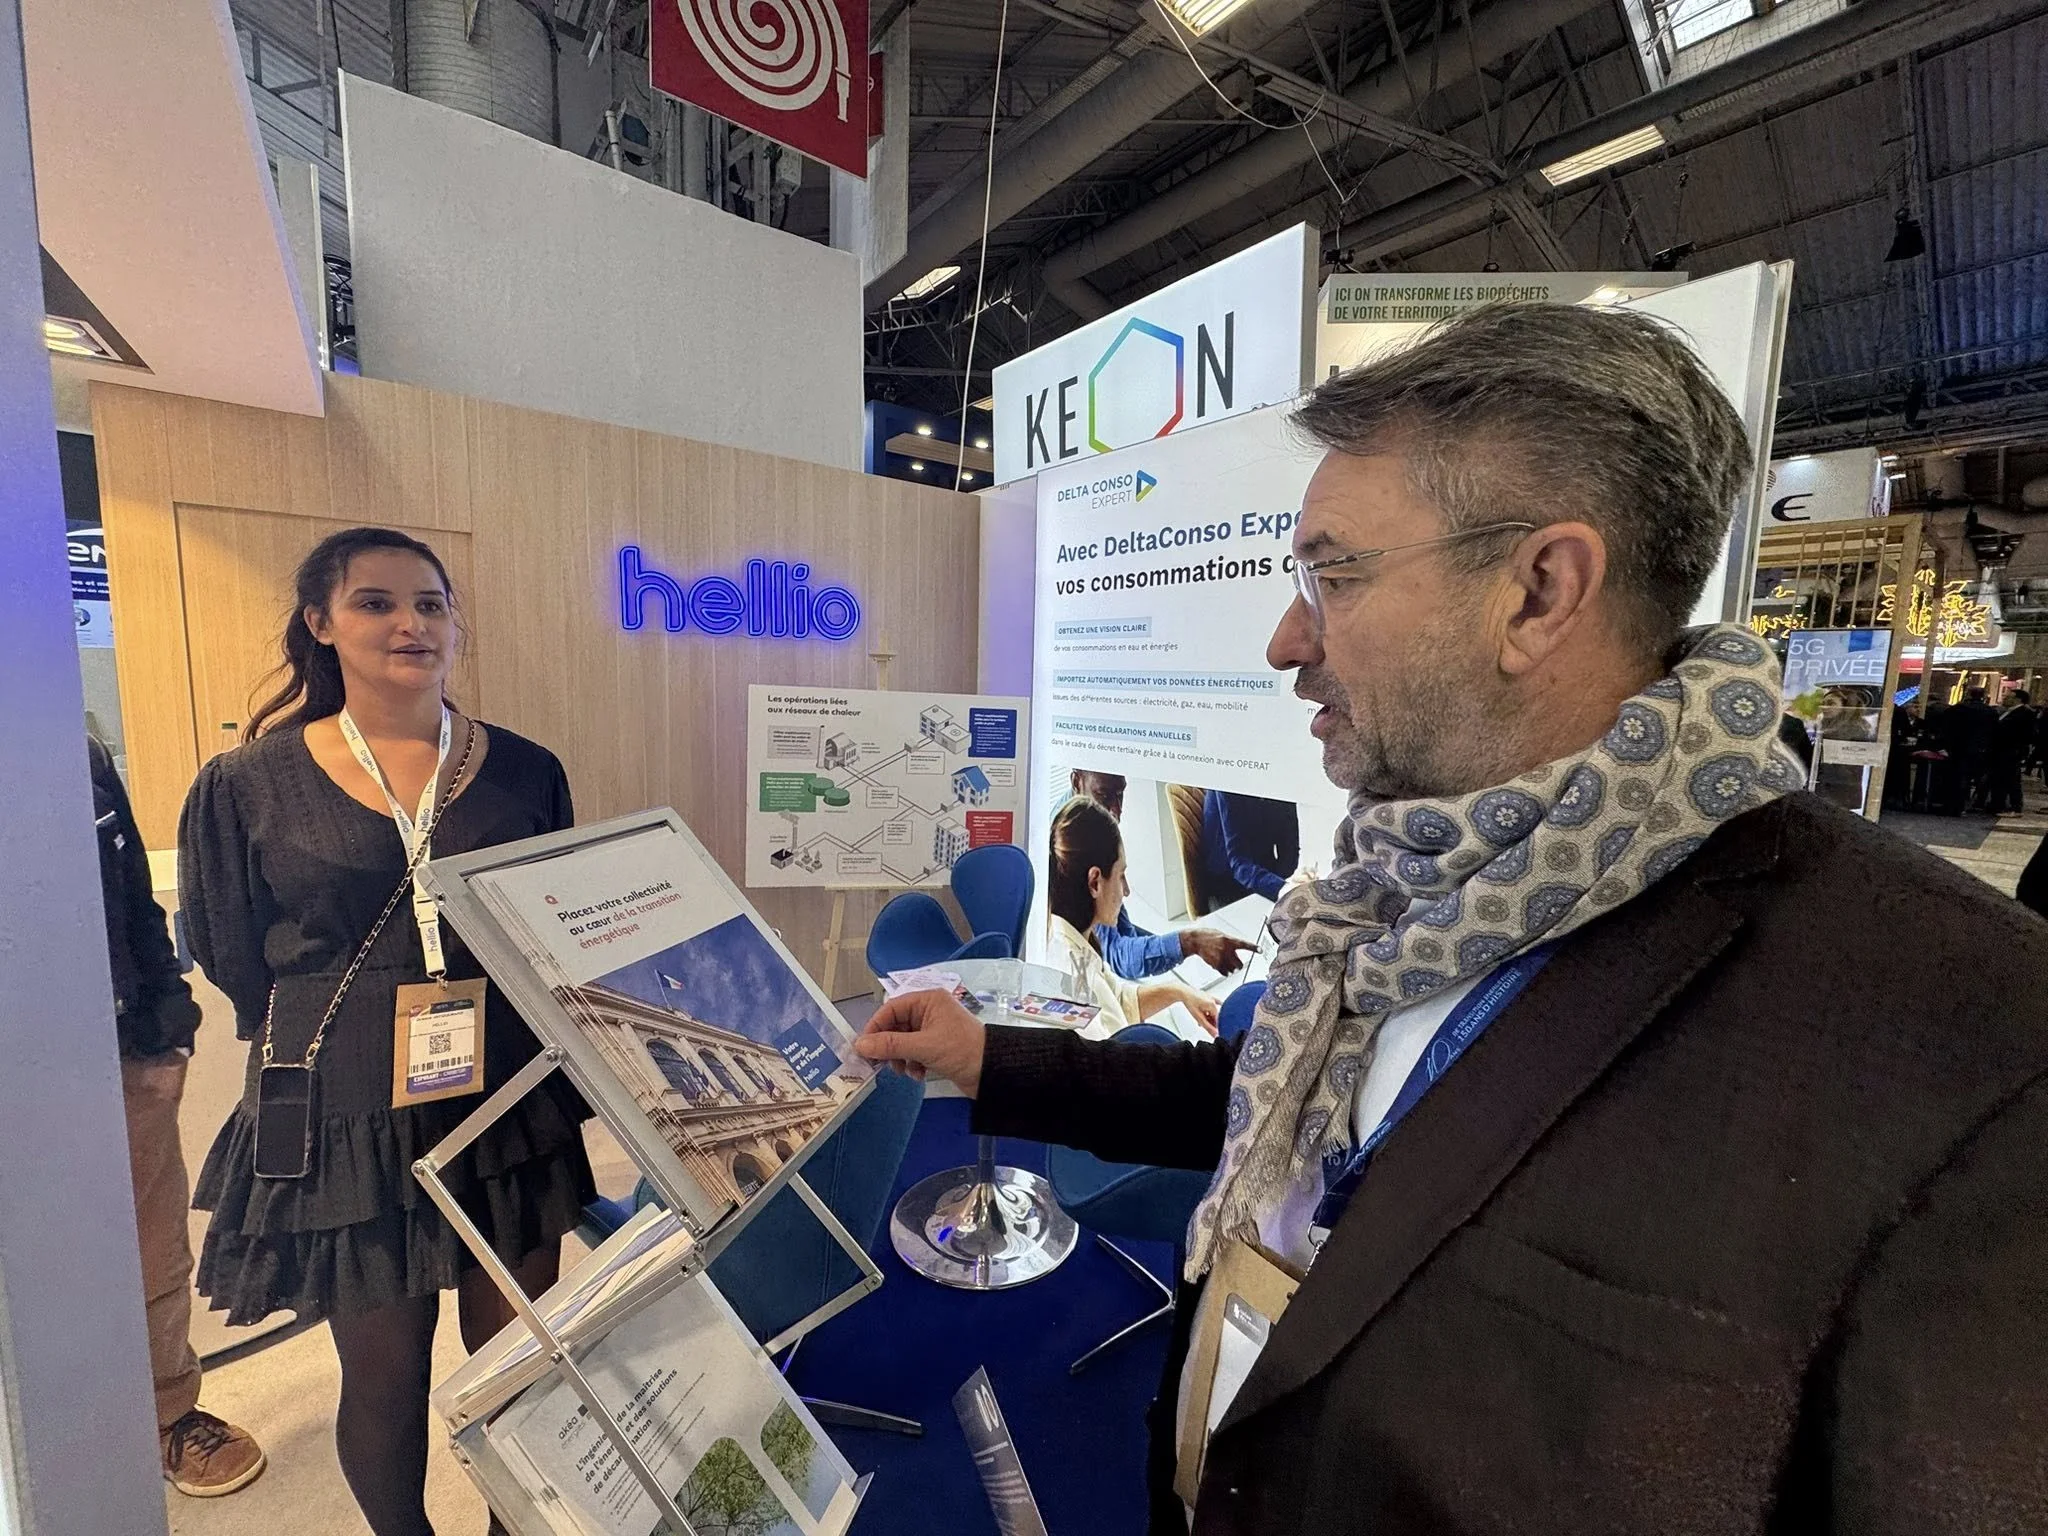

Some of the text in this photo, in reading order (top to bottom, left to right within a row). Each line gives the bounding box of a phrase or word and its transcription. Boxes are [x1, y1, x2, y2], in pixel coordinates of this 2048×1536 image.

[1335, 283, 1549, 301] ICI ON TRANSFORME LES BIODÉCHETS
[1334, 306, 1348, 319] DE
[1352, 306, 1388, 319] VOTRE
[1058, 474, 1133, 502] DELTA CONSO
[1092, 490, 1132, 509] EXPERT
[1057, 542, 1098, 564] Avec
[1104, 521, 1231, 557] DeltaConso
[1056, 577, 1085, 595] vos
[1091, 555, 1272, 592] consommations
[619, 546, 860, 640] hellio
[1123, 624, 1146, 632] CLAIRE
[1150, 642, 1178, 651] énergies
[1790, 638, 1825, 656] 5G
[1787, 655, 1885, 677] PRIVÉE
[1087, 677, 1151, 685] AUTOMATIQUEMENT
[1170, 677, 1205, 686] DONNÉES
[1208, 678, 1273, 690] ÉNERGÉTIQUES
[784, 695, 828, 704] opérations
[1143, 696, 1179, 707] électricité,
[1181, 700, 1195, 709] gaz,
[1215, 702, 1248, 711] mobilité
[785, 706, 816, 714] réseaux
[832, 708, 861, 716] chaleur
[1055, 722, 1083, 730] FACILITEZ
[1098, 725, 1146, 737] DÉCLARATIONS
[1149, 731, 1191, 741] ANNUELLES
[360, 750, 375, 772] hellio
[1097, 744, 1115, 752] décret
[1117, 746, 1141, 755] tertiaire
[1143, 749, 1160, 757] grâce
[1169, 751, 1175, 759] la
[1177, 753, 1214, 764] connexion
[1237, 760, 1269, 770] OPERAT
[396, 810, 409, 833] hellio
[419, 808, 430, 833] hellio
[558, 880, 672, 922] Placez votre collectivité
[569, 892, 682, 936] au cœur de la transition
[425, 928, 438, 952] hellio
[580, 922, 640, 949] énergétique
[782, 1042, 799, 1055] Votre
[617, 1410, 626, 1422] de
[625, 1401, 635, 1411] la
[559, 1416, 578, 1439] akéa
[585, 1470, 595, 1482] de
[625, 1421, 634, 1432] et
[633, 1406, 647, 1422] des
[646, 1369, 677, 1406] solutions
[593, 1481, 603, 1494] de
